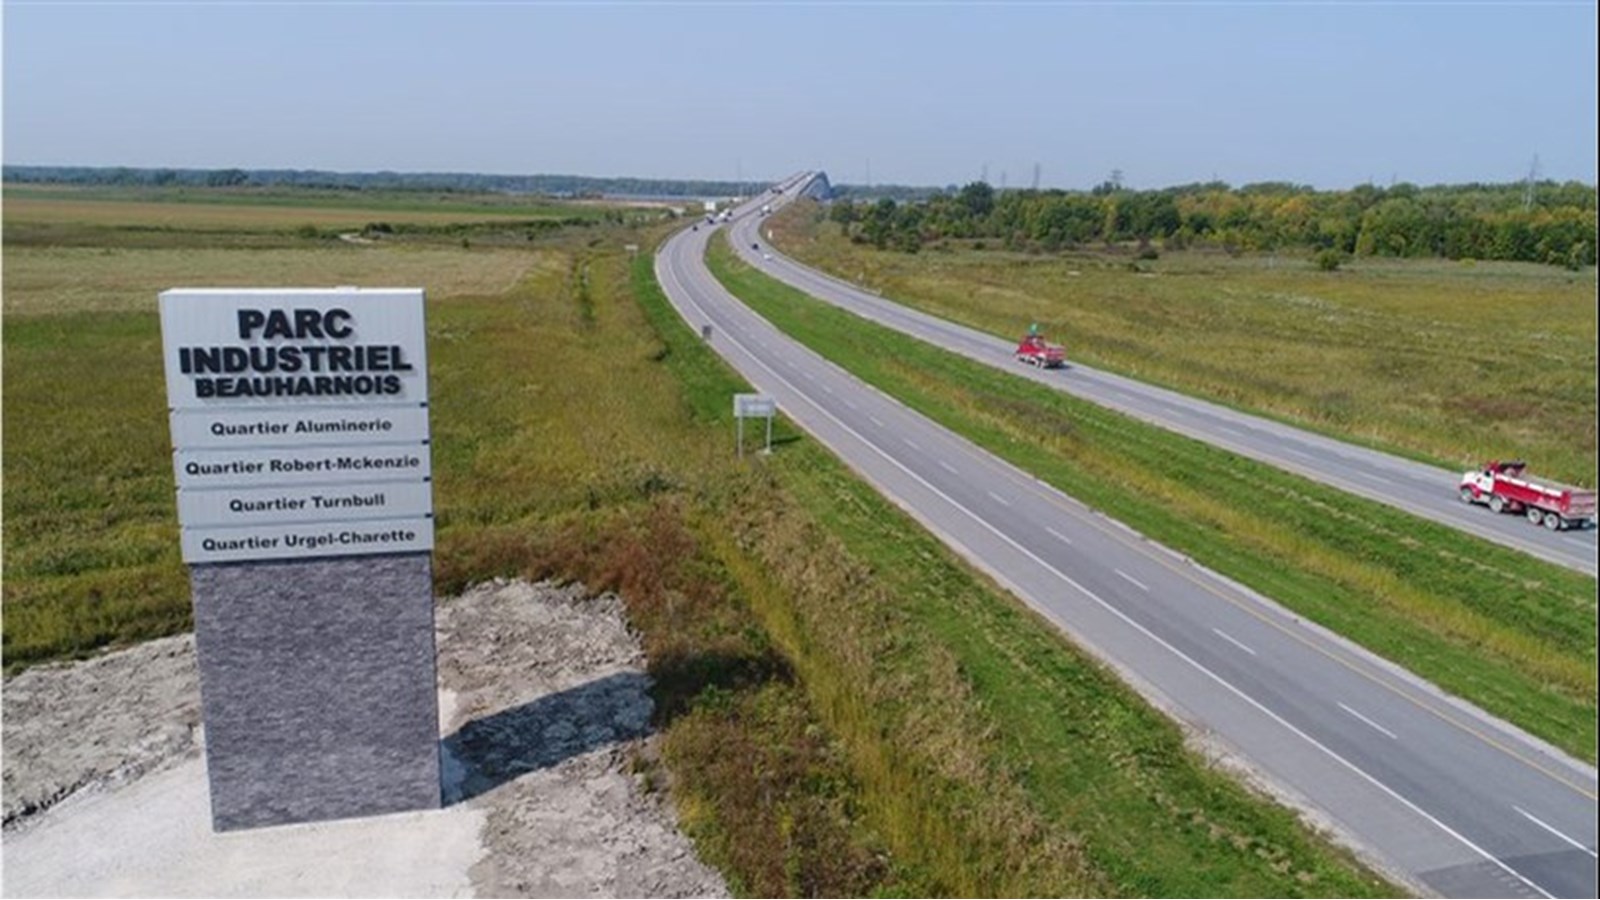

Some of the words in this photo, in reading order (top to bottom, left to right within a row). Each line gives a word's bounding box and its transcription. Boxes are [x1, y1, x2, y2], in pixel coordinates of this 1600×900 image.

[237, 309, 353, 340] PARC
[179, 346, 412, 374] INDUSTRIEL
[195, 375, 401, 398] BEAUHARNOIS
[210, 421, 289, 436] Quartier
[294, 418, 392, 433] Aluminerie
[185, 460, 263, 475] Quartier
[269, 455, 420, 472] Robert-Mckenzie
[229, 497, 306, 512] Quartier
[311, 494, 385, 508] Turnbull
[202, 536, 278, 551] Quartier
[284, 529, 416, 549] Urgel-Charette
